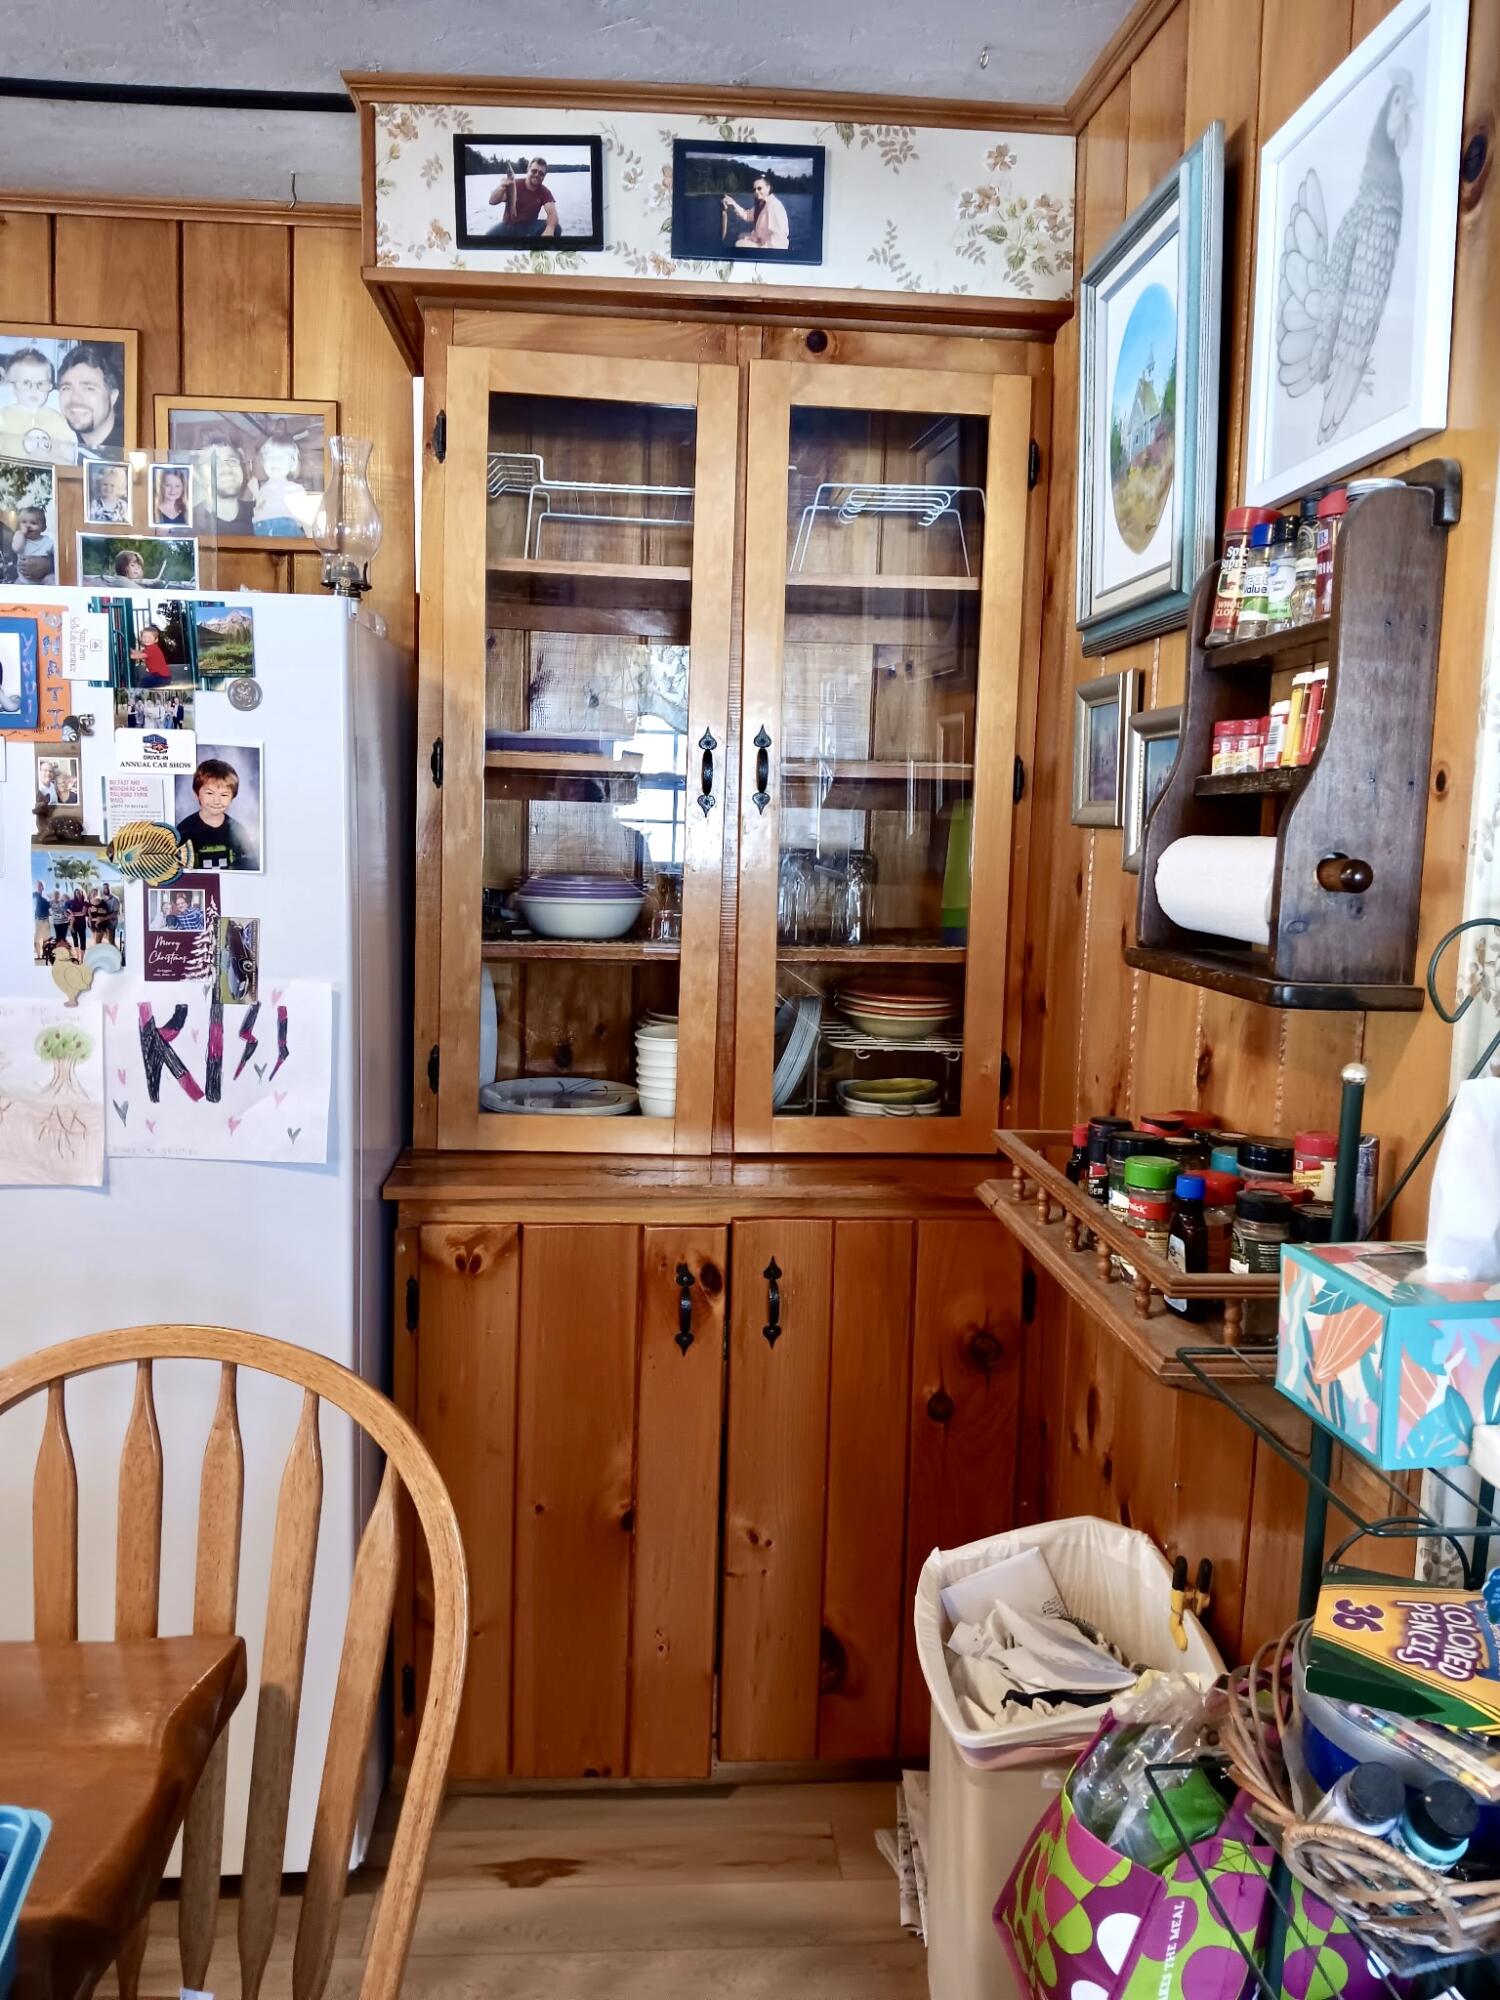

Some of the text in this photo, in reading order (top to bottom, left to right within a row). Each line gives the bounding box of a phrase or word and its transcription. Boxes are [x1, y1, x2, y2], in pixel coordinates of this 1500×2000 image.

[1221, 558, 1248, 571] Supre
[1226, 546, 1250, 560] Spic
[1246, 575, 1269, 585] eat
[154, 935, 181, 952] Merry
[148, 950, 188, 965] Christmas
[1332, 1599, 1384, 1632] 36
[1396, 1601, 1442, 1668] PENCILS
[1438, 1604, 1480, 1679] COLORED
[1169, 1900, 1185, 1941] MEAL
[1164, 1942, 1177, 1972] THE
